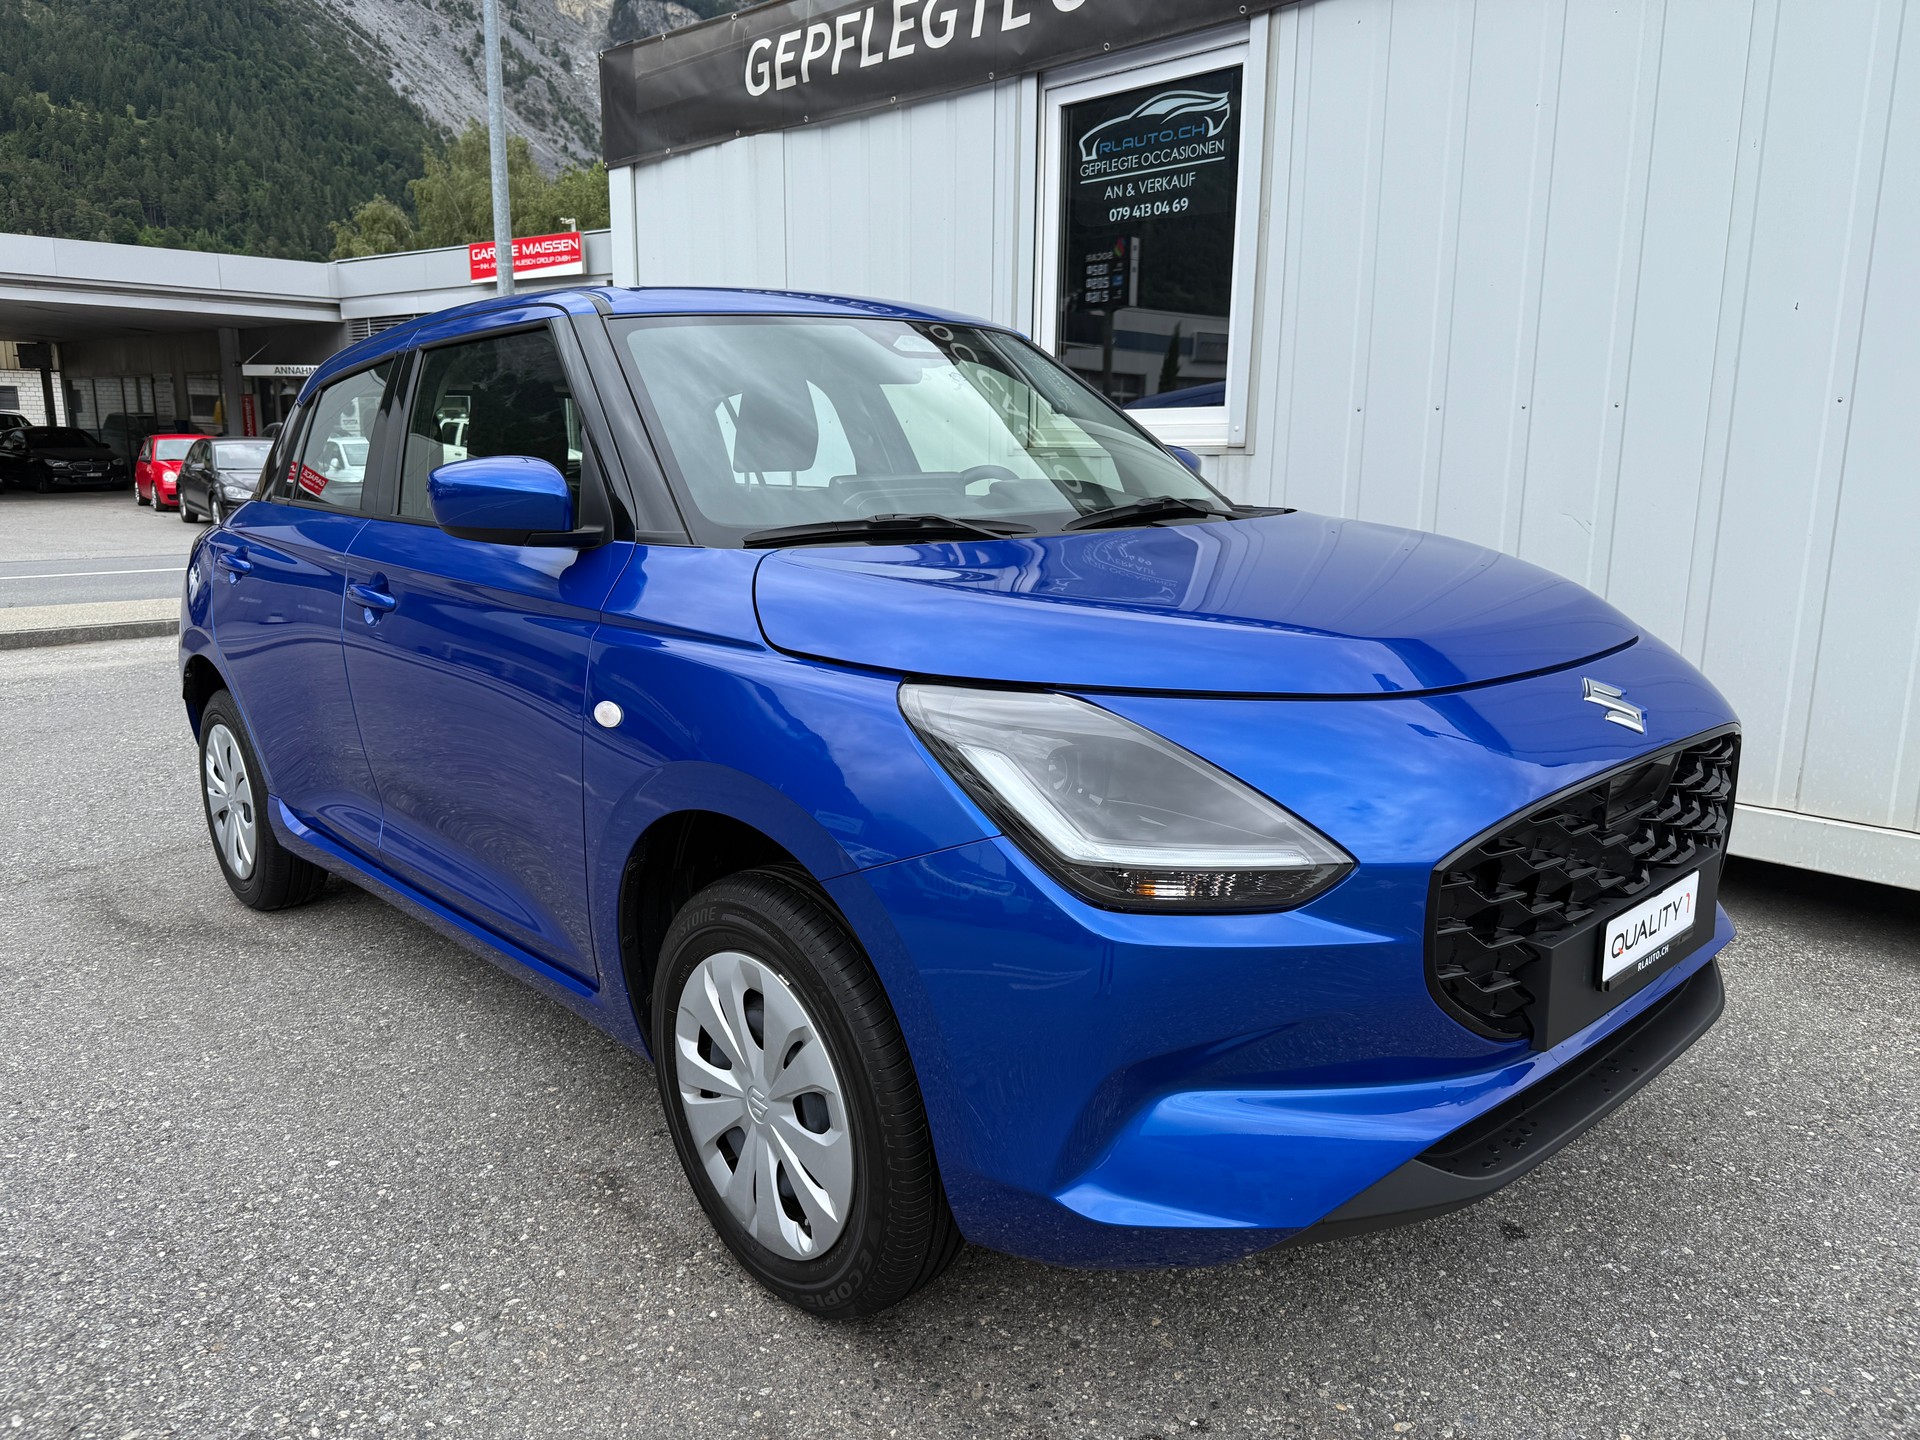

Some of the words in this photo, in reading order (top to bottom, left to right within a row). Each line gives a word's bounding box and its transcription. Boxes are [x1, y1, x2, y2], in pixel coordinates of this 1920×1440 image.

[1100, 123, 1205, 154] RLAUTO.CH
[1079, 155, 1139, 177] GEPFLEGTE
[1140, 139, 1225, 166] OCCASIONEN
[1103, 184, 1123, 200] AN
[1125, 183, 1136, 197] &
[1138, 171, 1196, 194] VERKAUF
[1108, 207, 1131, 222] 079
[1132, 203, 1151, 218] 413
[1153, 201, 1170, 215] 04
[1172, 197, 1189, 211] 69
[471, 244, 519, 261] GARE
[522, 239, 579, 256] MAISSEN
[1611, 896, 1683, 959] QUALITY
[1686, 892, 1691, 914] 1
[1638, 944, 1669, 971] RLAUTO.CH
